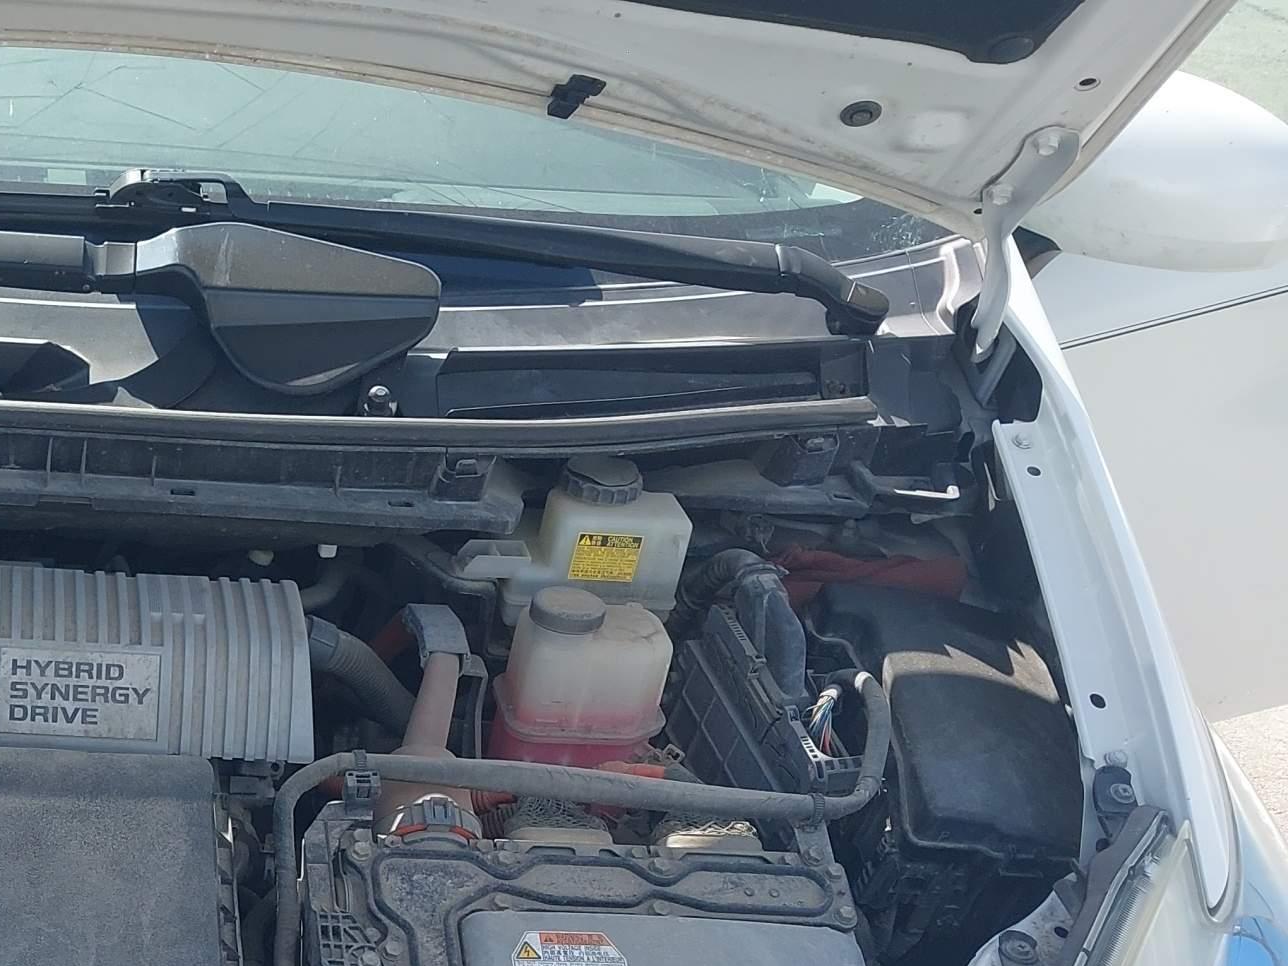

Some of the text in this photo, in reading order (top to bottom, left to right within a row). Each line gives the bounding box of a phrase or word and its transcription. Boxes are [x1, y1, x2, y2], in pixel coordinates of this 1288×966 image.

[11, 658, 124, 681] HYBRID
[9, 681, 151, 705] SYNERGY
[8, 703, 99, 725] DRIVE
